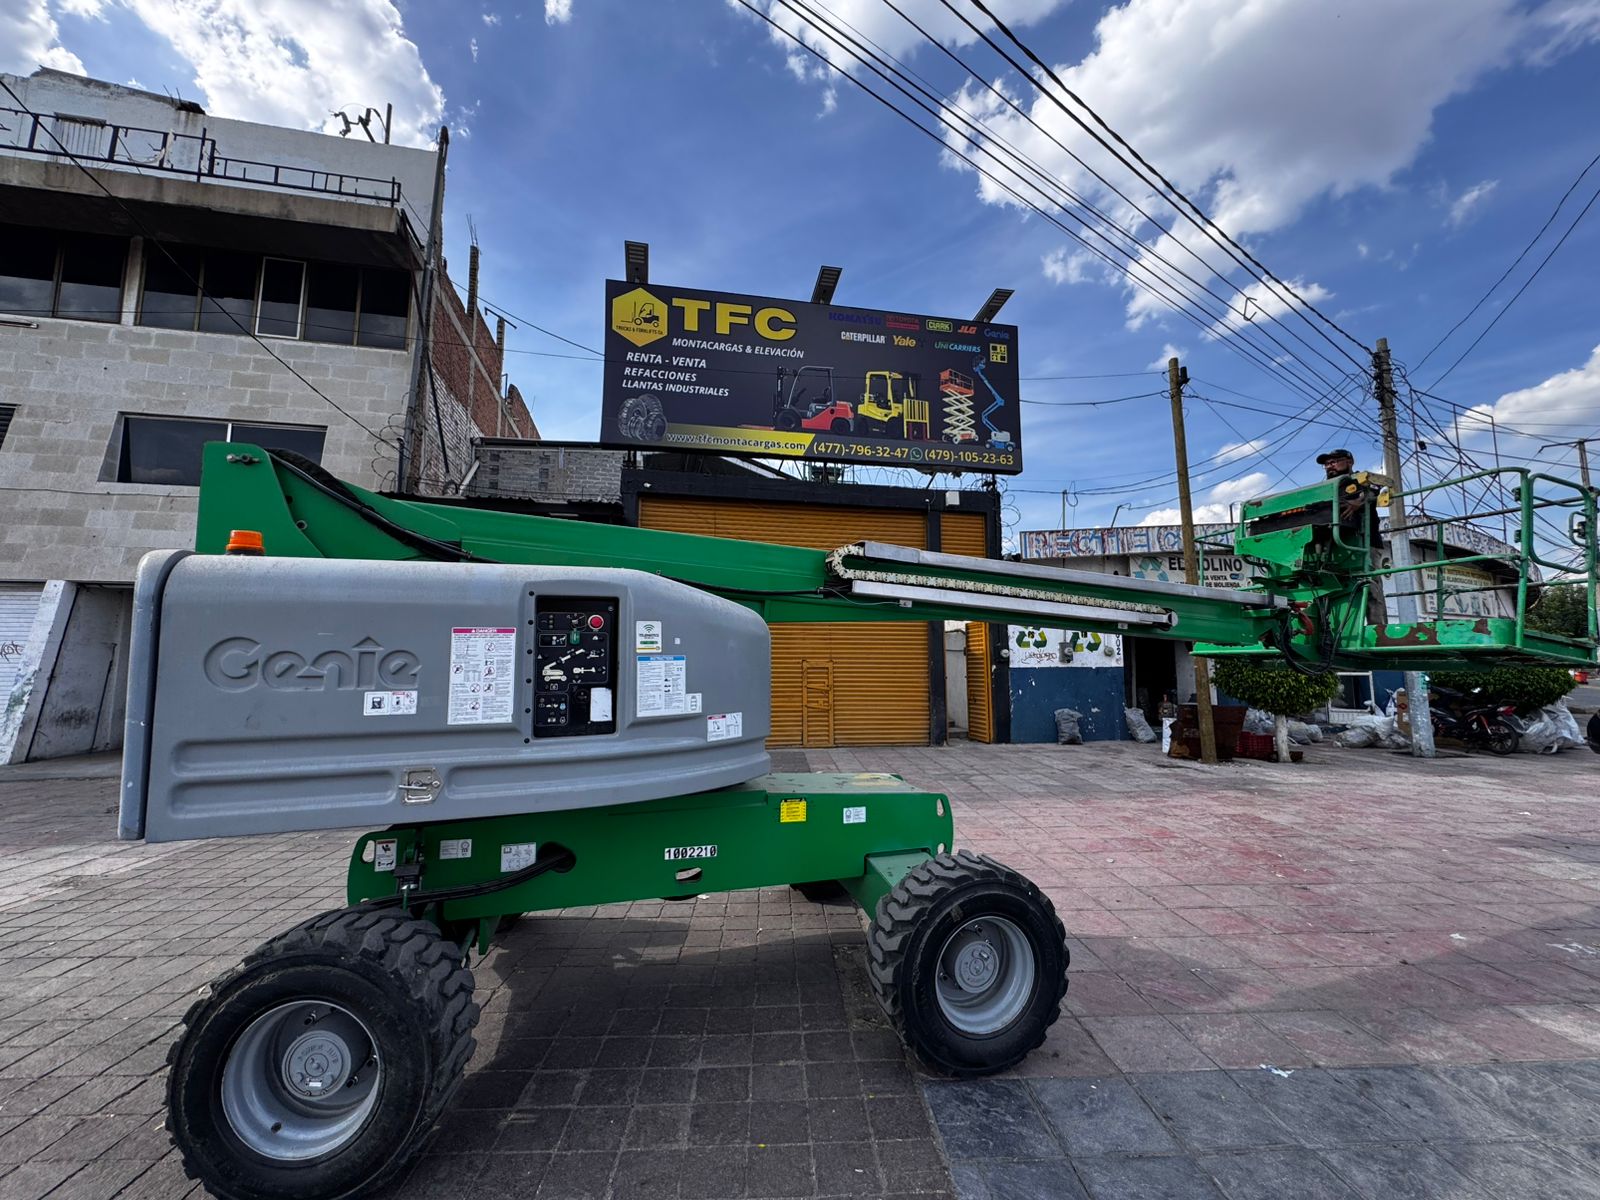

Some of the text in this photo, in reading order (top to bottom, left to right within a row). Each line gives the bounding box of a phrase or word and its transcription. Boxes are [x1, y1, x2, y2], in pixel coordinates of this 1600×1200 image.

[672, 297, 798, 342] TFC
[829, 312, 882, 325] KOMATSU
[928, 321, 950, 331] CLARK
[958, 325, 977, 334] JLG
[984, 328, 1010, 339] Genie
[841, 331, 886, 344] CATERPILLAR
[893, 335, 916, 347] Yale
[672, 338, 805, 359] MONTACARGAS & ELEVACIÓN
[626, 352, 662, 365] RENTA
[672, 356, 707, 369] VENTA
[624, 367, 697, 382] REFACCIONES
[622, 380, 730, 397] LLANTAS INDUSTRIALES
[665, 433, 806, 450] www.tfcmontacargas.com
[813, 442, 909, 459] (477)-796-32-47
[924, 448, 1014, 466] (479)-105-23-63
[1168, 557, 1185, 570] EL
[203, 635, 423, 694] Genie
[666, 845, 717, 859] 1002210
